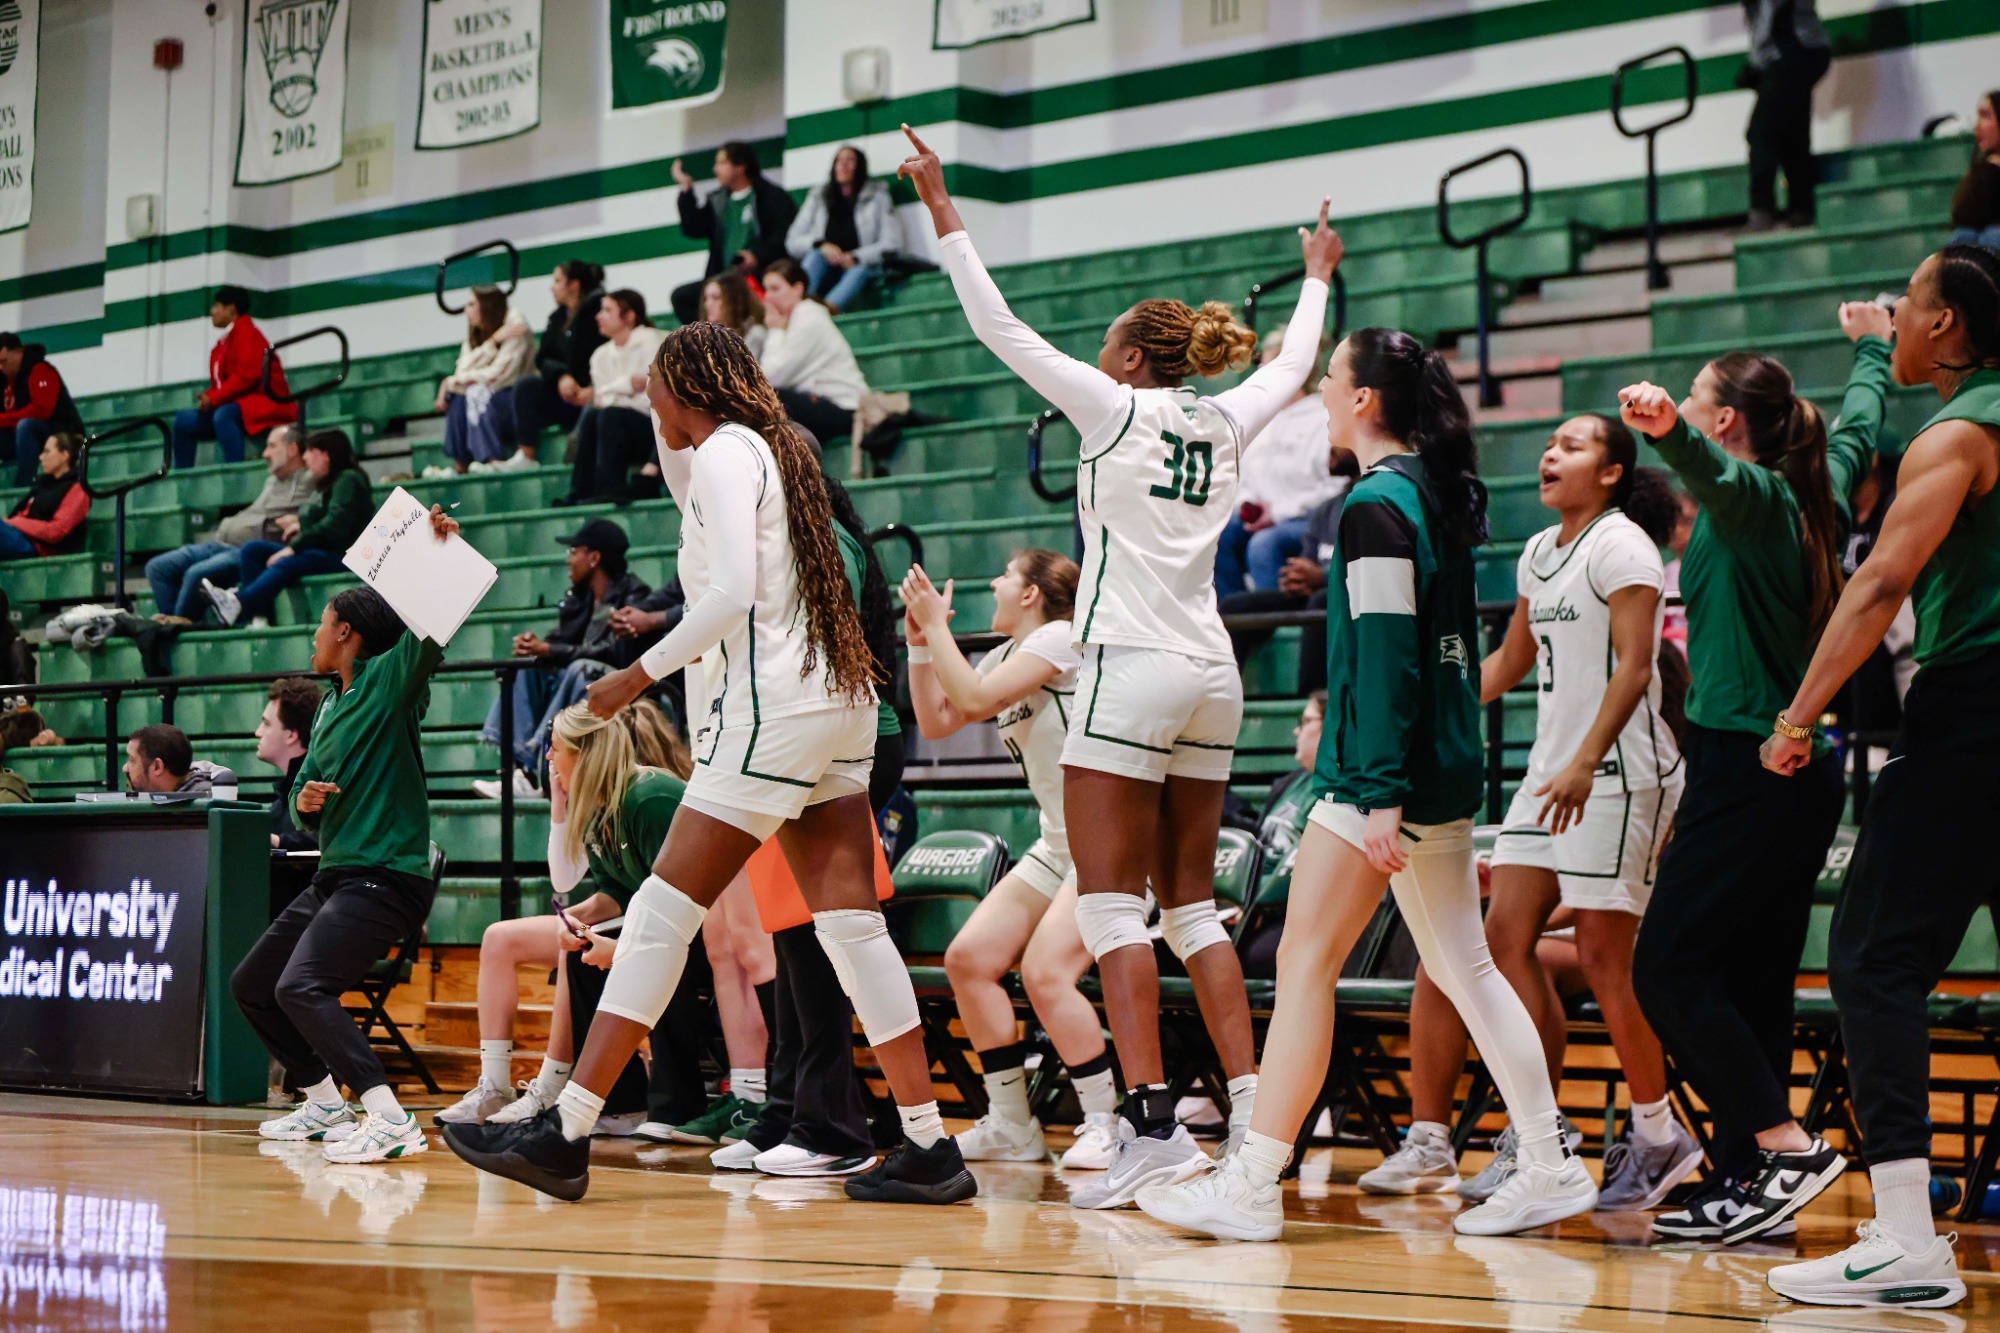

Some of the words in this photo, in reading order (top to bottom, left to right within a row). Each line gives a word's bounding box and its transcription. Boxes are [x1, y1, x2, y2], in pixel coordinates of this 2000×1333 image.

[454, 7, 511, 36] MEN'S
[664, 0, 726, 29] ROUND
[433, 62, 533, 104] CHAMPIONS
[272, 123, 317, 156] 2002
[1149, 430, 1213, 506] 30
[1541, 635, 1553, 692] 3
[908, 847, 988, 867] WAGNER
[3, 877, 178, 953] University
[68, 949, 173, 1002] Center
